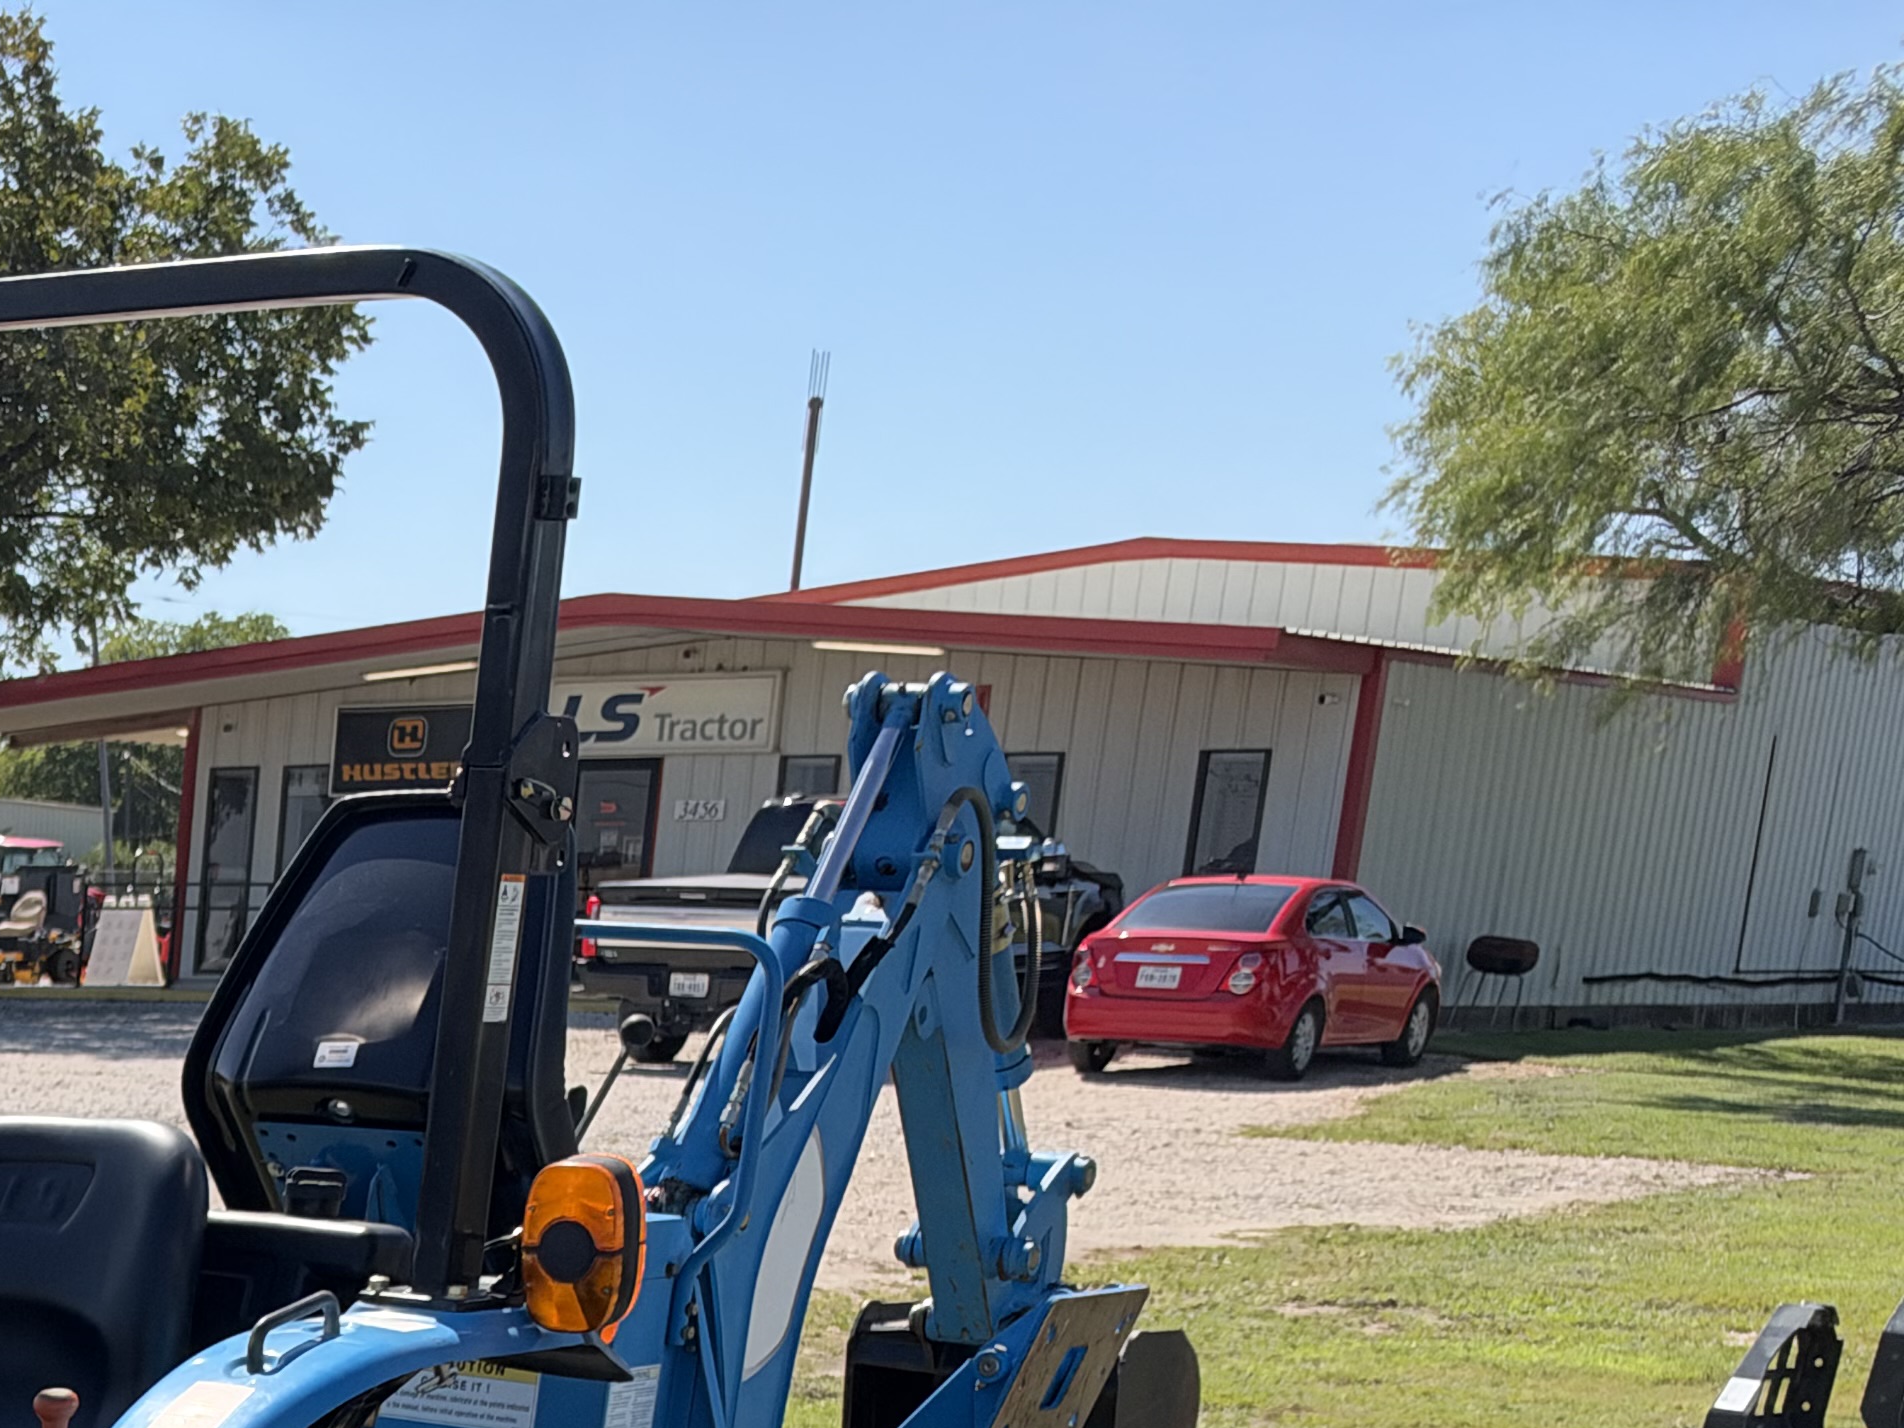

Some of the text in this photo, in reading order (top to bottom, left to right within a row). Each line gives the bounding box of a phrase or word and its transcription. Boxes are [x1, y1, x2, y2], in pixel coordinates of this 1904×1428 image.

[654, 713, 763, 743] Tractor
[678, 801, 720, 820] 3456
[449, 1361, 506, 1376] UTION
[471, 1382, 482, 1393] IT
